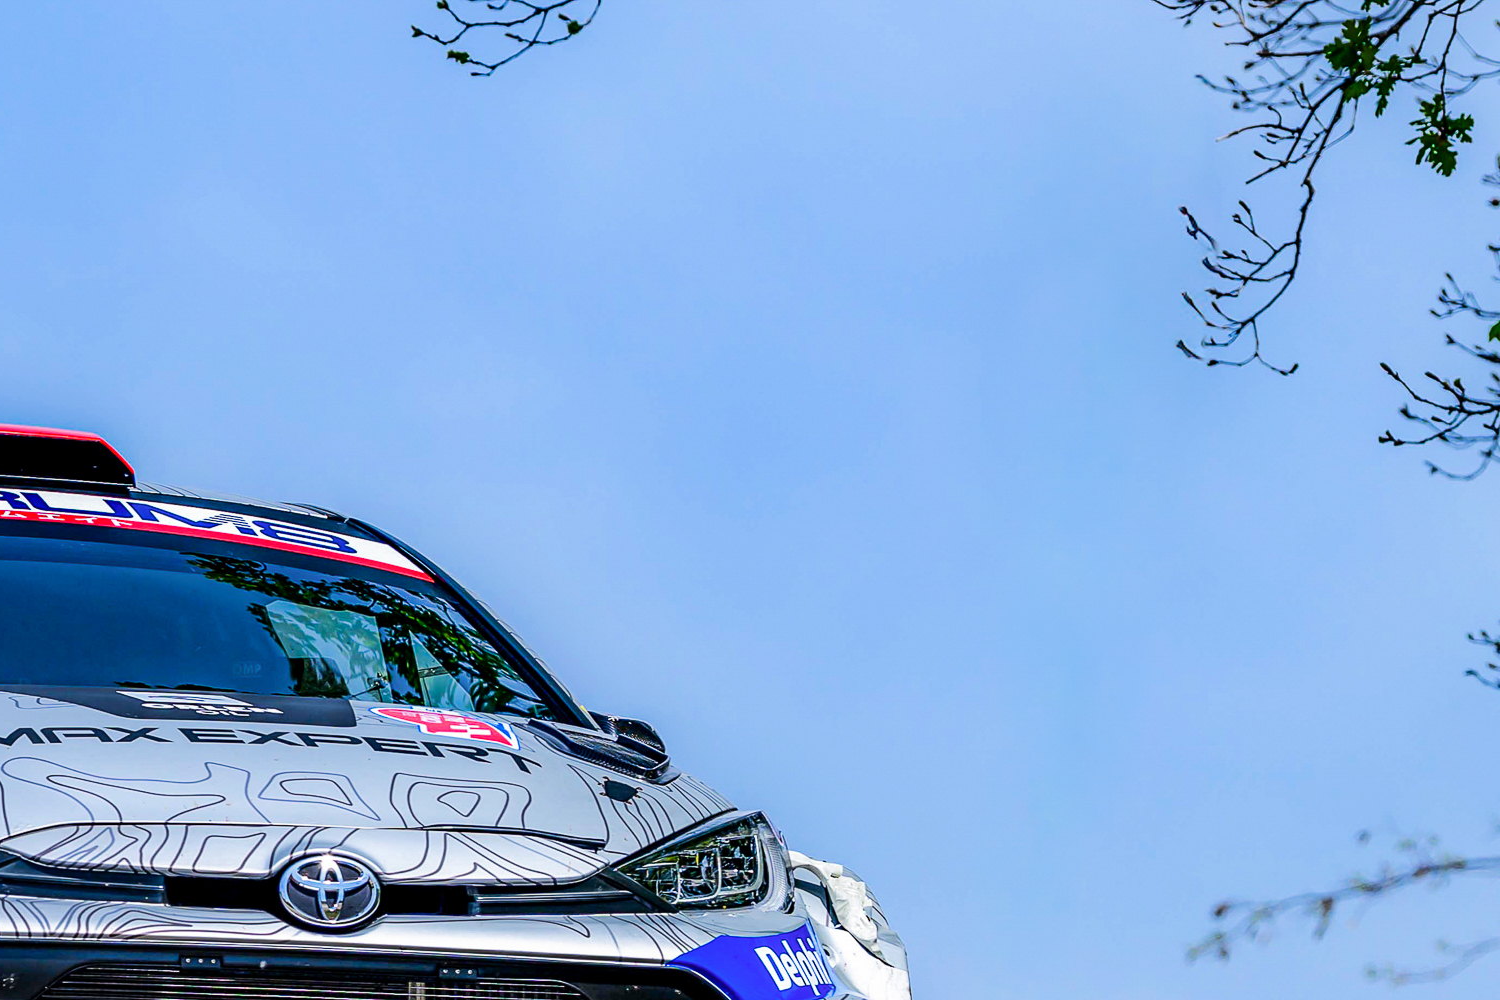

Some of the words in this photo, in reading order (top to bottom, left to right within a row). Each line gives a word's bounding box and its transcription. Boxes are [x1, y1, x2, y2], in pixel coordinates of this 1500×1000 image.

[141, 702, 284, 714] ORLEN
[171, 728, 543, 775] EXPERT
[754, 937, 832, 997] Delphi
